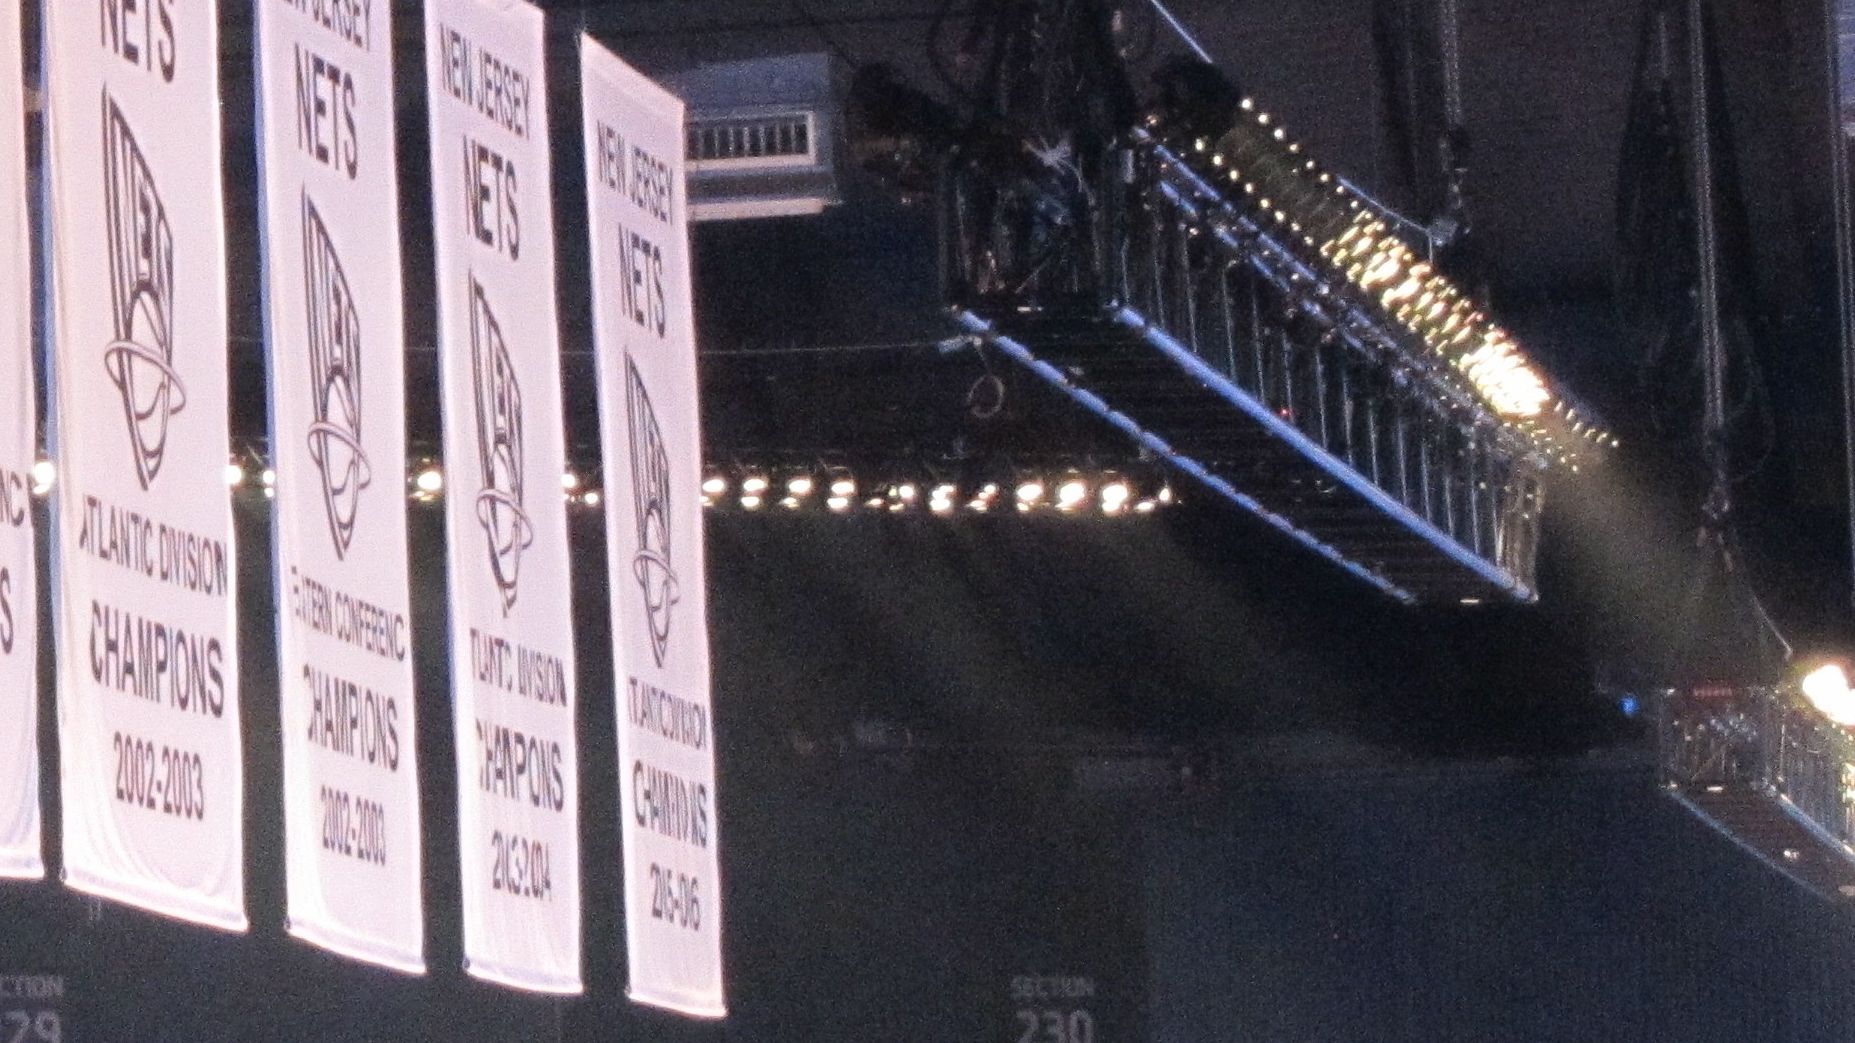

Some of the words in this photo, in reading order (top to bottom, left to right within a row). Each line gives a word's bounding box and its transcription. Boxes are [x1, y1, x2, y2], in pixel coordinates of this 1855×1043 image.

[295, 42, 358, 181] NETS
[440, 22, 473, 106] NEW
[477, 47, 530, 141] JERSEY
[463, 134, 520, 261] NETS
[597, 120, 626, 196] NEW
[619, 222, 665, 339] NETS
[159, 523, 228, 596] DIVISION
[90, 599, 225, 719] CHAMPIONS
[114, 731, 204, 821] 2002-2003
[1017, 1009, 1094, 1043] 230
